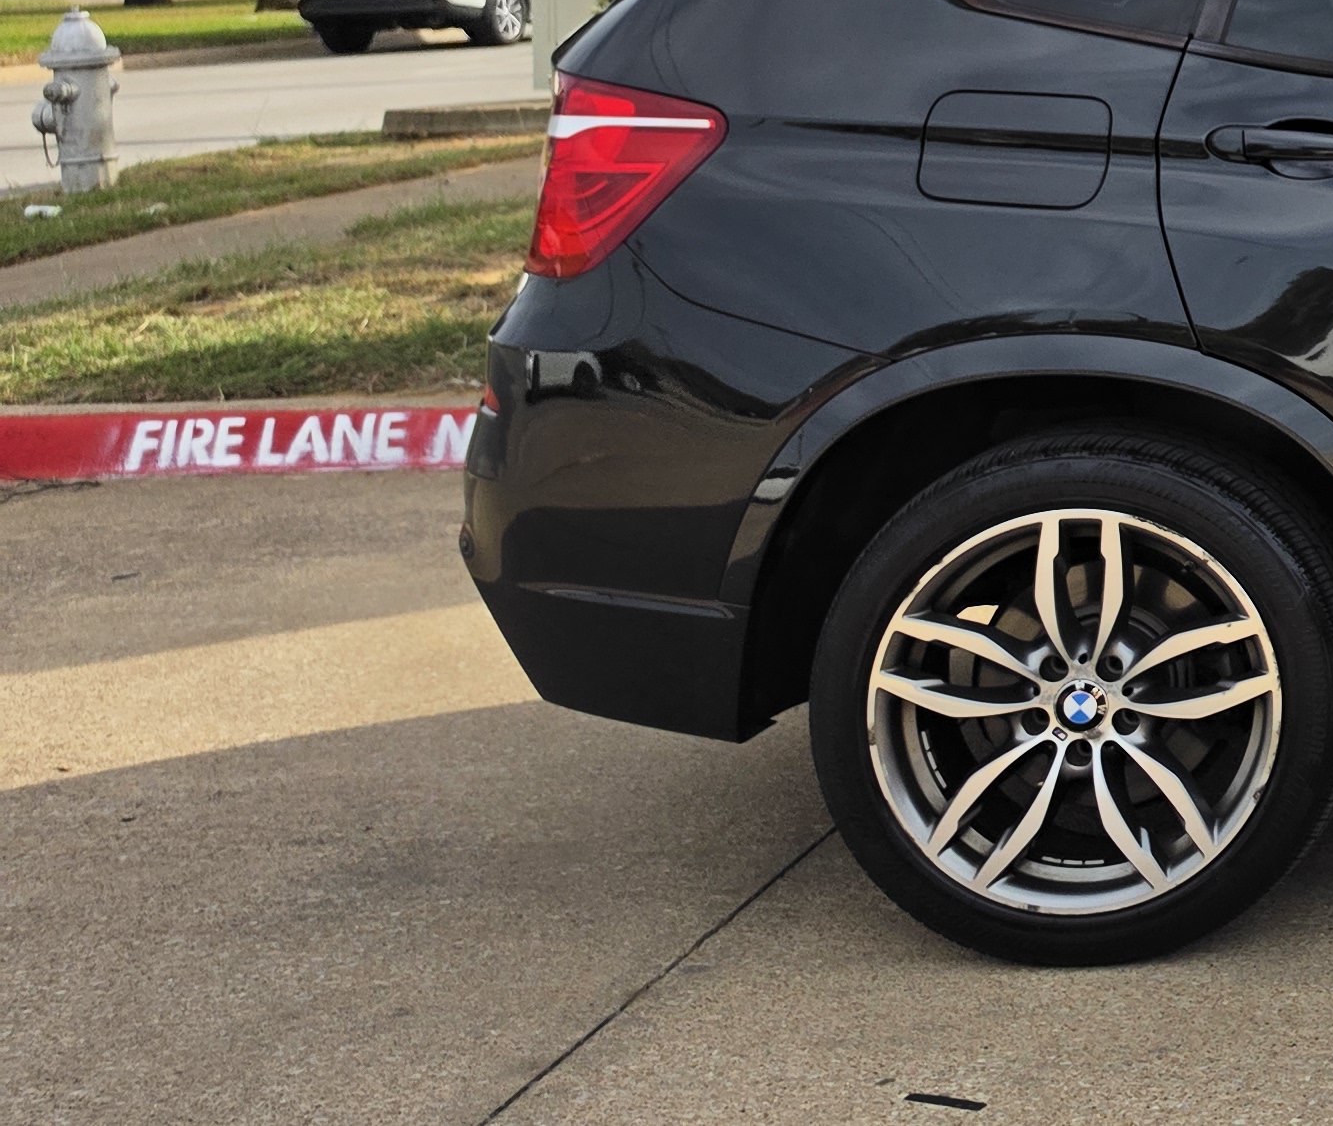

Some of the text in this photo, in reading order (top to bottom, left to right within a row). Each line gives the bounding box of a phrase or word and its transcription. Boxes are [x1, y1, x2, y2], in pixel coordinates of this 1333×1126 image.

[124, 412, 478, 472] FIRE LANE N
